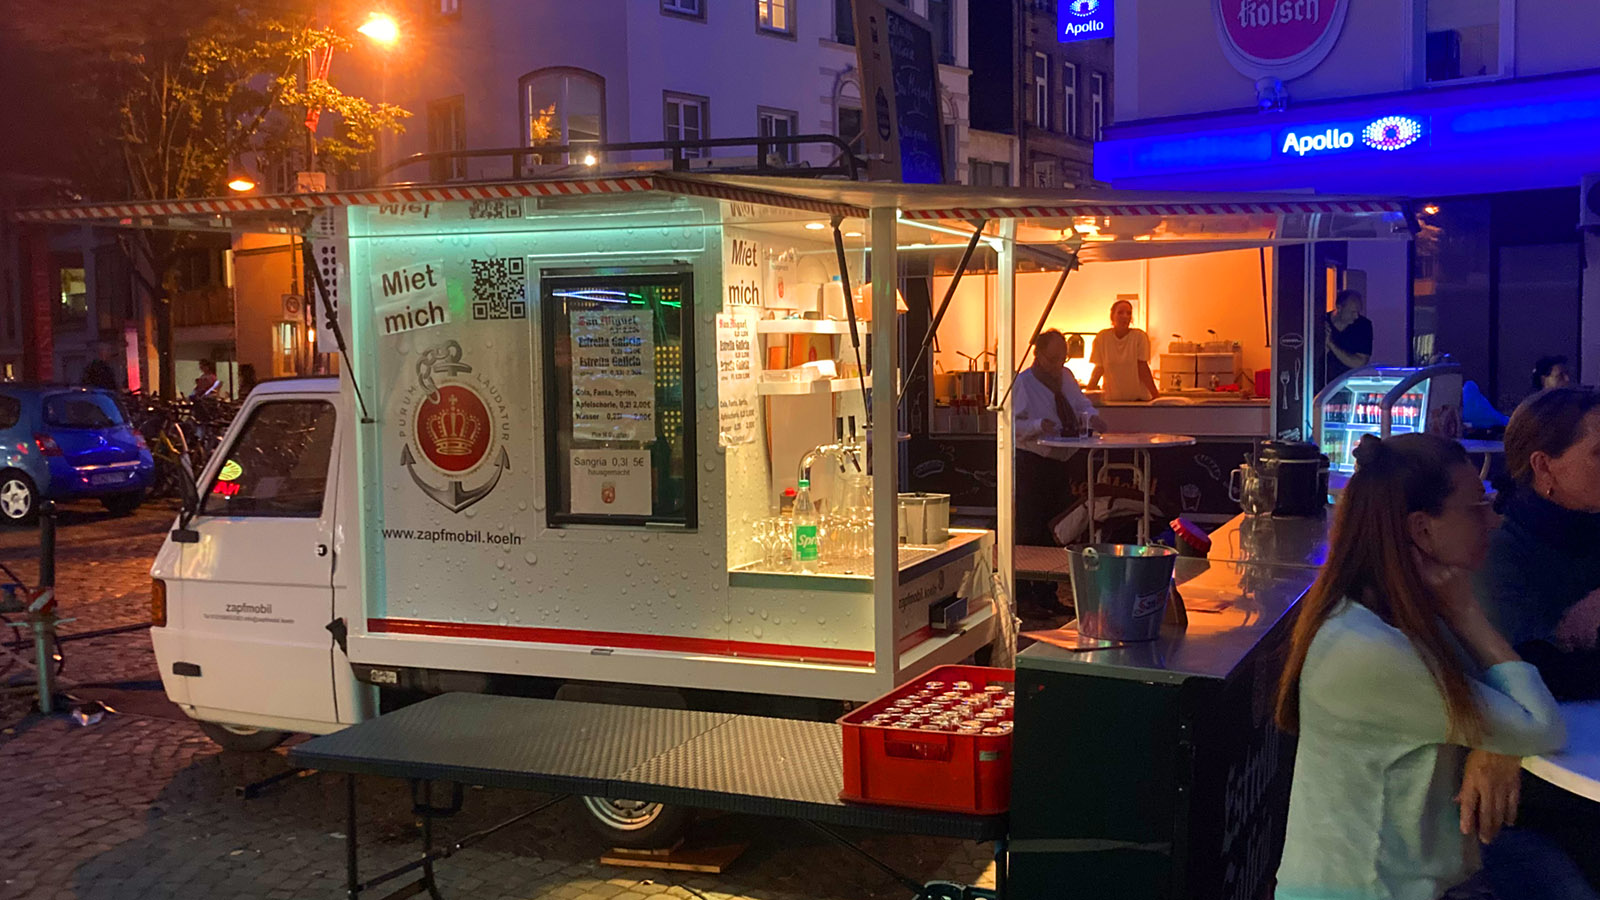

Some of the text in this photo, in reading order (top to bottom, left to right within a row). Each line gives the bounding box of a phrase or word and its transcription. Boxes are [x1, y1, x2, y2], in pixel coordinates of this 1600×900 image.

[1065, 20, 1104, 36] Apollo
[1282, 129, 1354, 156] Apollo
[731, 239, 758, 267] Miet
[381, 264, 437, 297] Miet
[729, 280, 759, 305] mich
[384, 301, 445, 333] mich
[593, 388, 614, 397] Fanta,
[615, 388, 637, 397] Sprite,
[398, 385, 416, 438] PURUM
[477, 372, 511, 441] LAUDATUR
[575, 401, 618, 410] Apfelschorle,
[574, 456, 607, 468] Sangria
[633, 457, 644, 467] 5€
[382, 528, 521, 545] www.zapfmobil.koeln
[225, 602, 272, 614] zapfmobil
